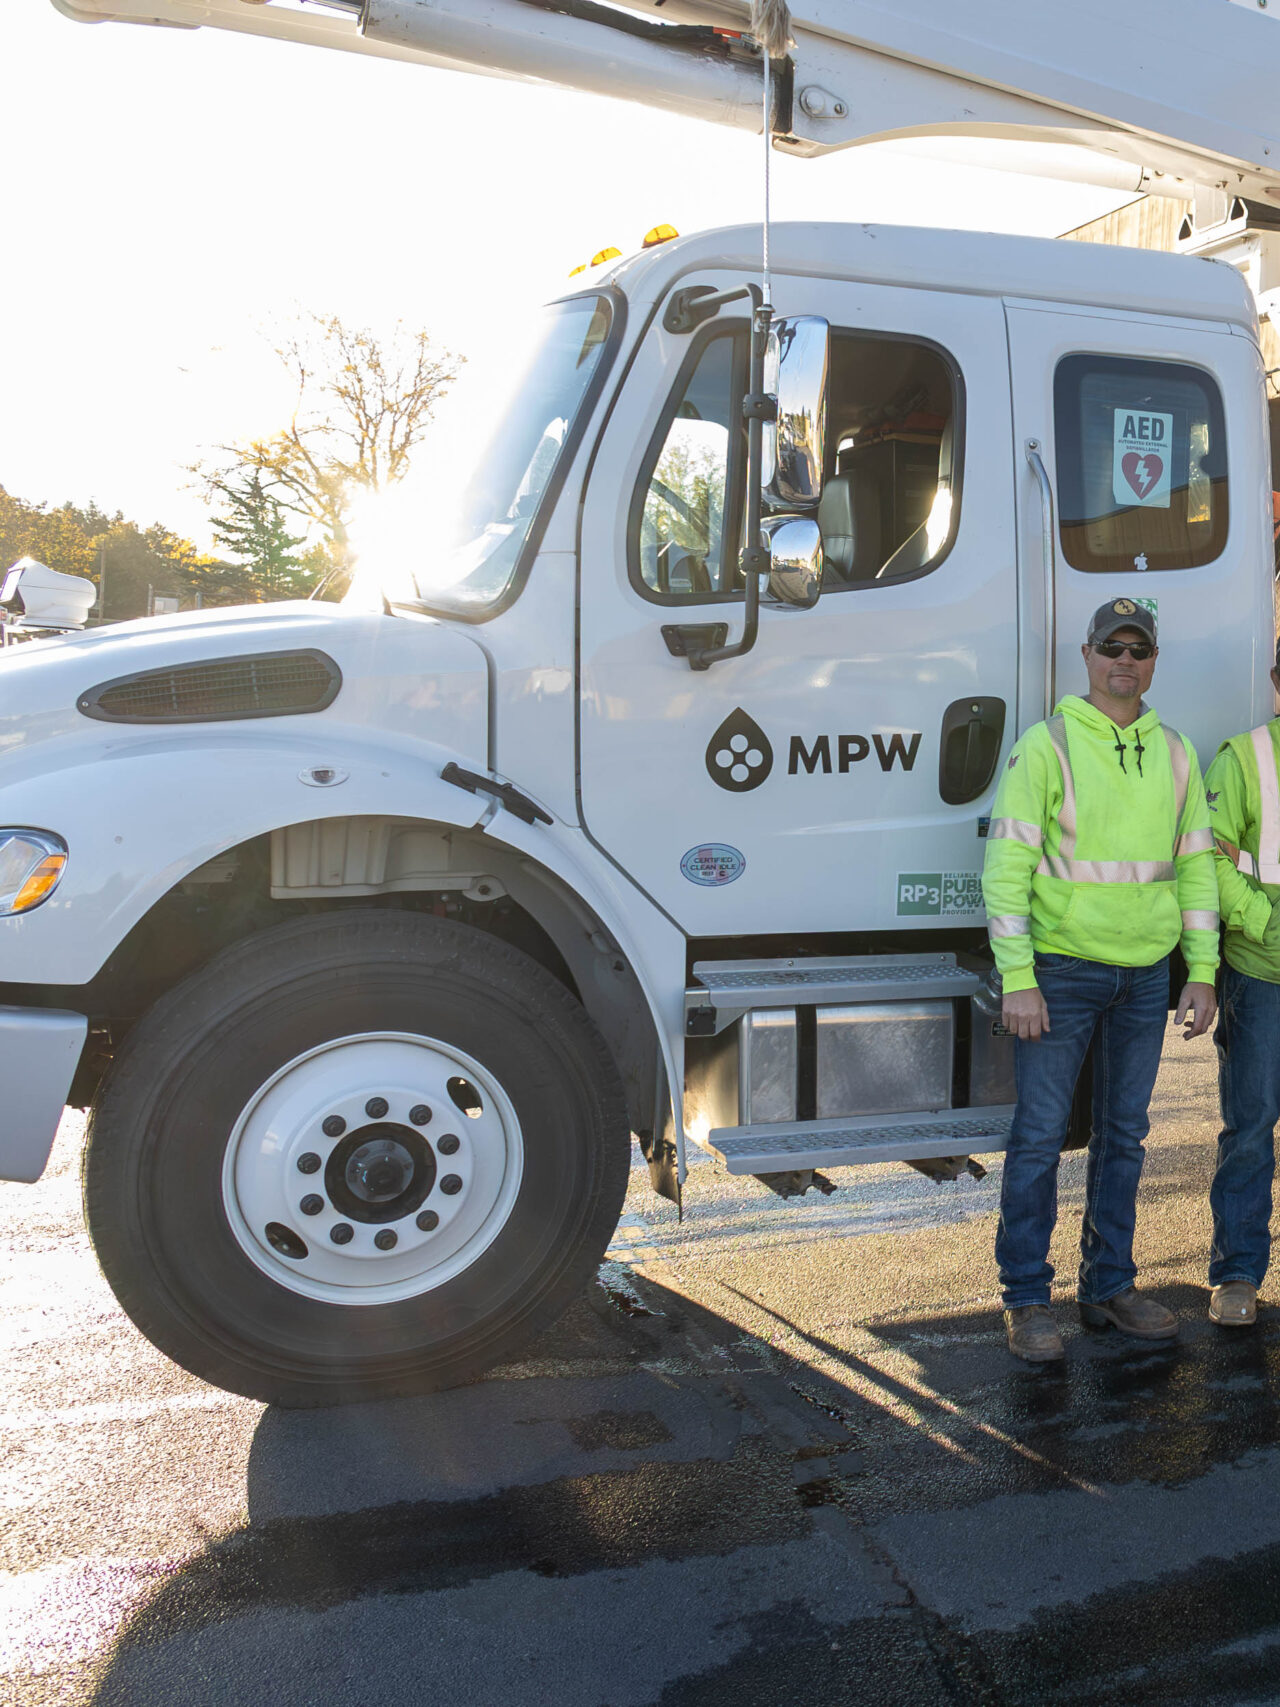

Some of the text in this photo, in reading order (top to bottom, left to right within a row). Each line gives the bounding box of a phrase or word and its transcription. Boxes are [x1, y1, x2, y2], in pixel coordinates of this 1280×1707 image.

[1122, 415, 1165, 441] AED
[788, 733, 923, 775] MPW
[900, 884, 940, 906] RP3
[943, 894, 985, 908] POW
